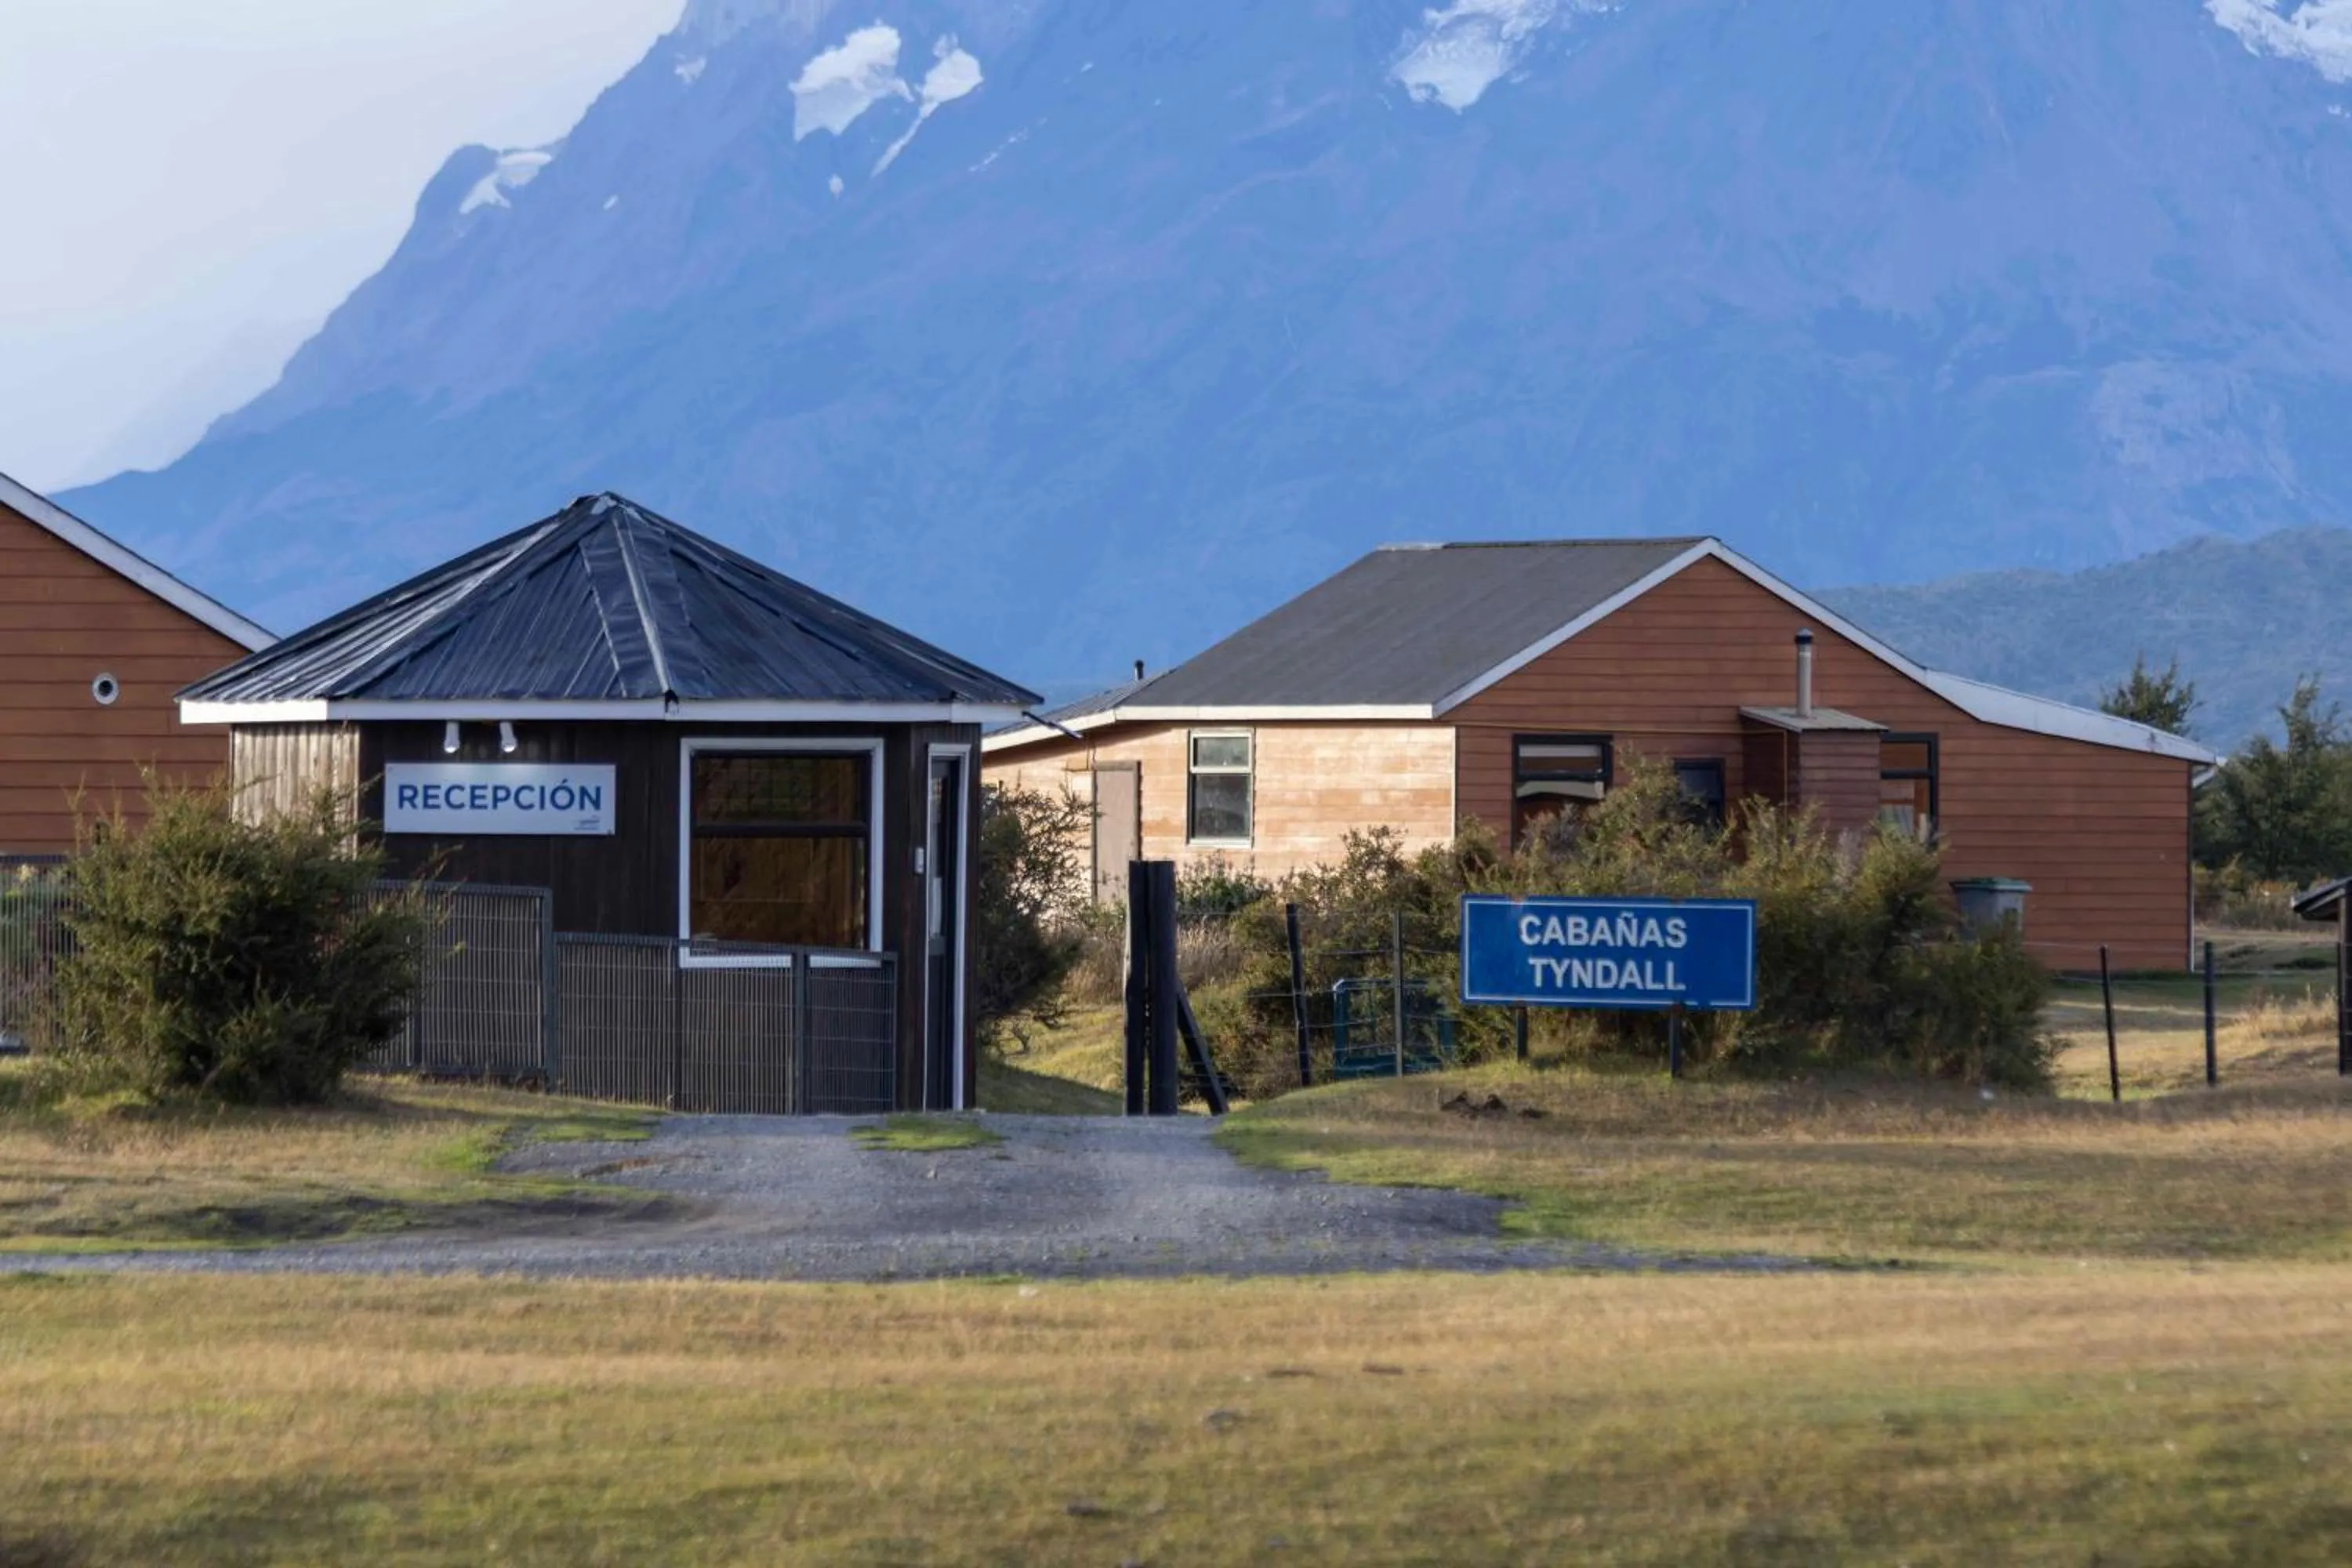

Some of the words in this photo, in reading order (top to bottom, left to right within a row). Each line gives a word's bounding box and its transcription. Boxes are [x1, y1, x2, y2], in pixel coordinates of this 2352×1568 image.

[397, 779, 601, 811] RECEPCIÓN
[1519, 912, 1687, 949] CABAÑAS
[1528, 957, 1686, 991] TYNDALL
